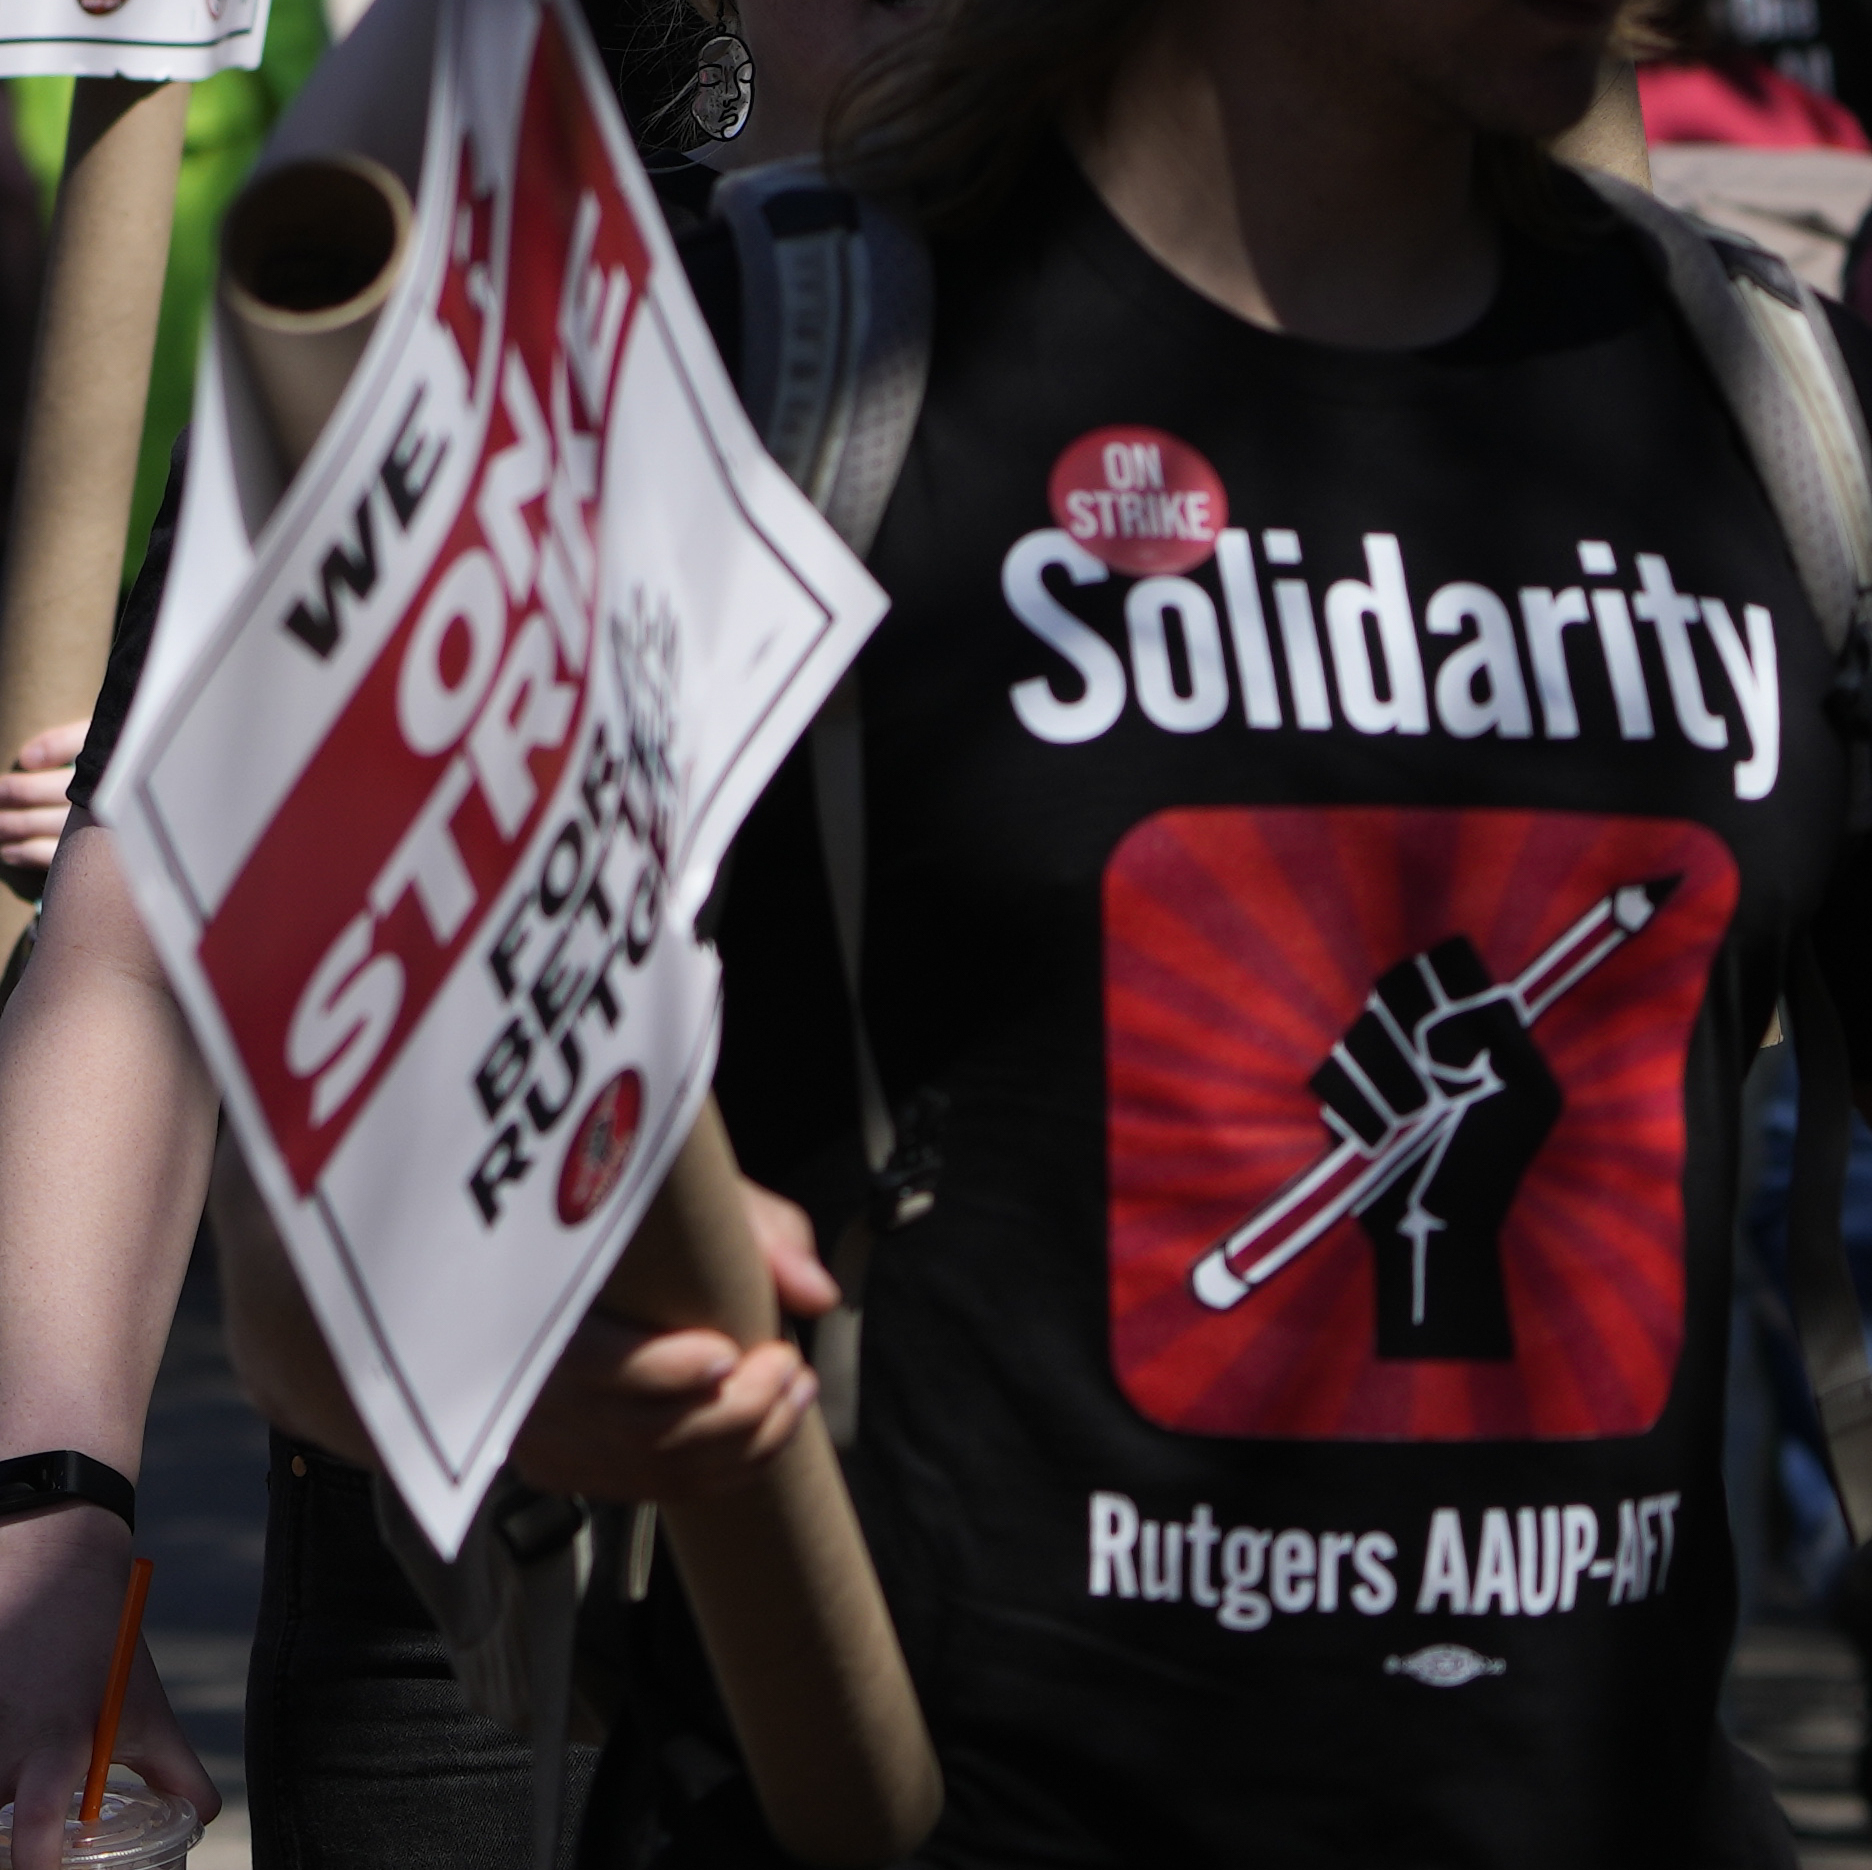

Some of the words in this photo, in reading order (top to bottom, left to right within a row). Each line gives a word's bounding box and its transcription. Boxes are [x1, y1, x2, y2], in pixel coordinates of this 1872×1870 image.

[282, 380, 453, 662] WE
[397, 340, 554, 758] ON
[1066, 489, 1215, 542] STRIKE
[1104, 441, 1165, 490] ON
[1002, 527, 1779, 799] Solidarity
[1088, 1489, 1398, 1632] Rutgers
[1416, 1490, 1682, 1617] AAUP-AFT
